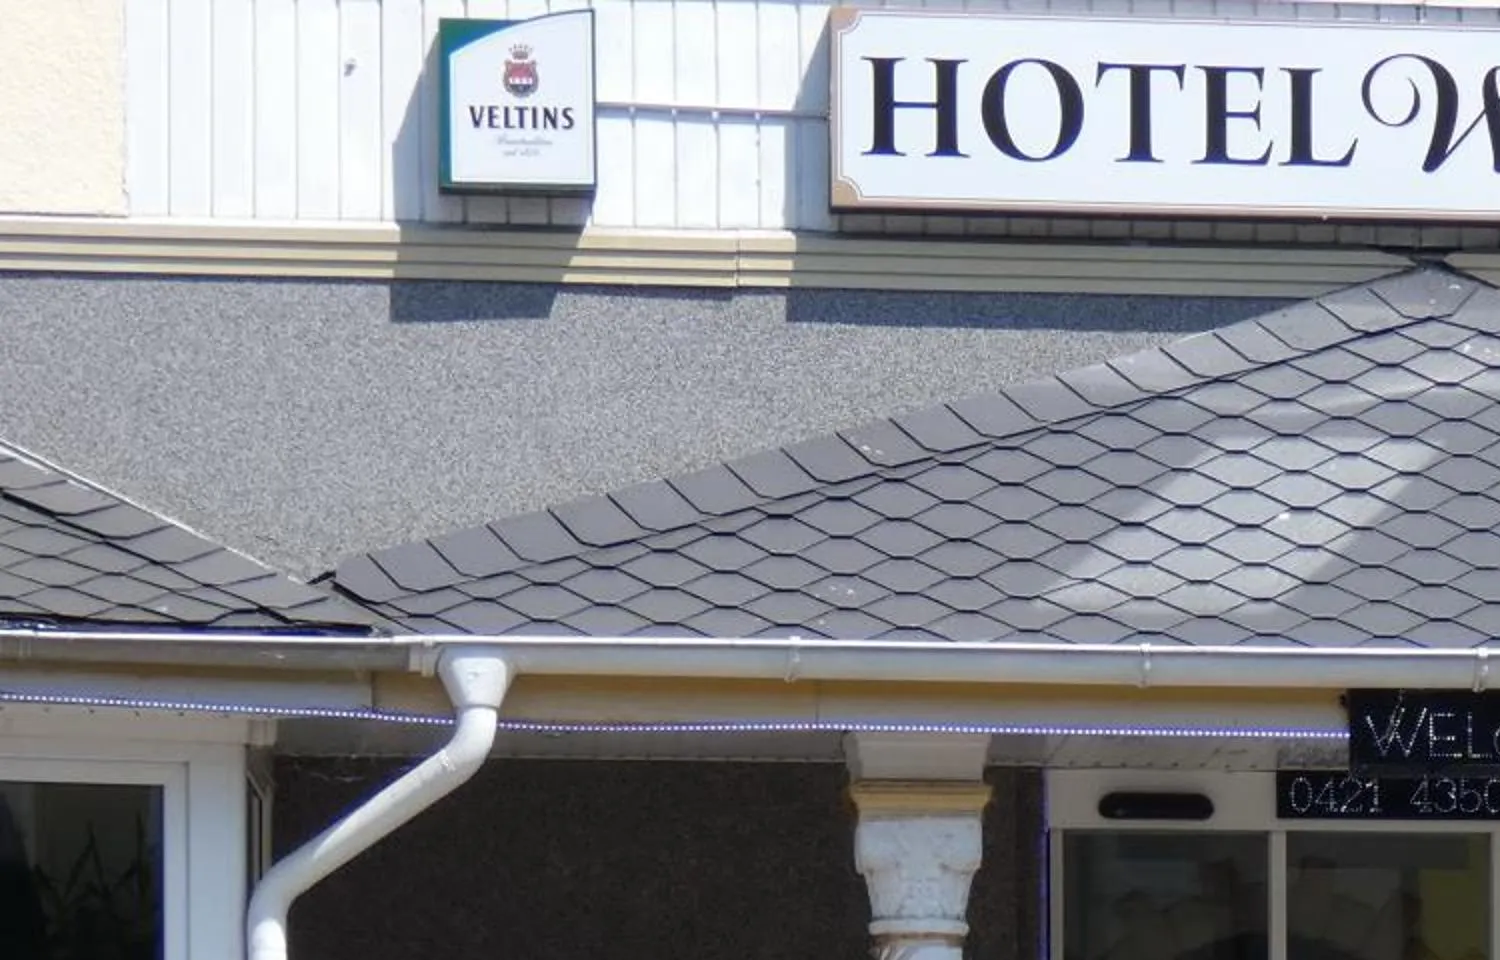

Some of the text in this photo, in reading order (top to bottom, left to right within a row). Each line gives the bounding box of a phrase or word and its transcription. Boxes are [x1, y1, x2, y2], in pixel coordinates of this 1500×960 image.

[469, 105, 575, 130] VELTINS
[861, 56, 1359, 167] HOTEL
[1289, 776, 1383, 814] 0421
